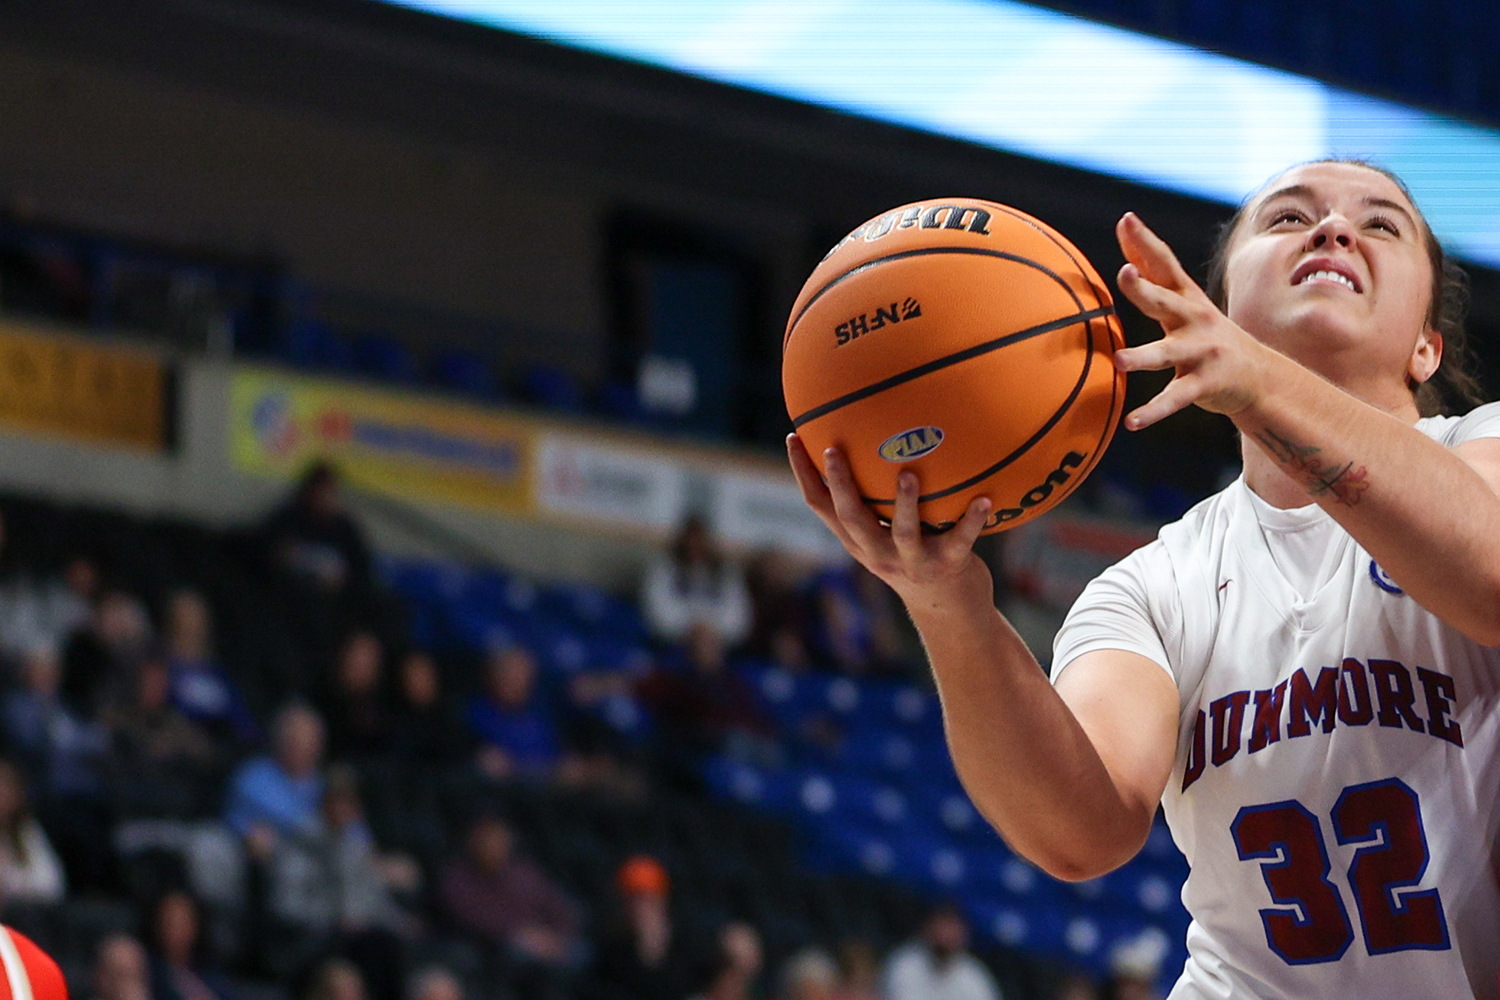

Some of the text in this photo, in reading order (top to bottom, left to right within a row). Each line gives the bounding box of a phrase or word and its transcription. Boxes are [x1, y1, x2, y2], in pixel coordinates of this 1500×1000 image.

[821, 205, 994, 263] Wil
[834, 303, 900, 347] NFHS
[881, 427, 942, 461] PIAA
[1182, 657, 1464, 794] DUNMORE
[1230, 777, 1452, 967] 32
